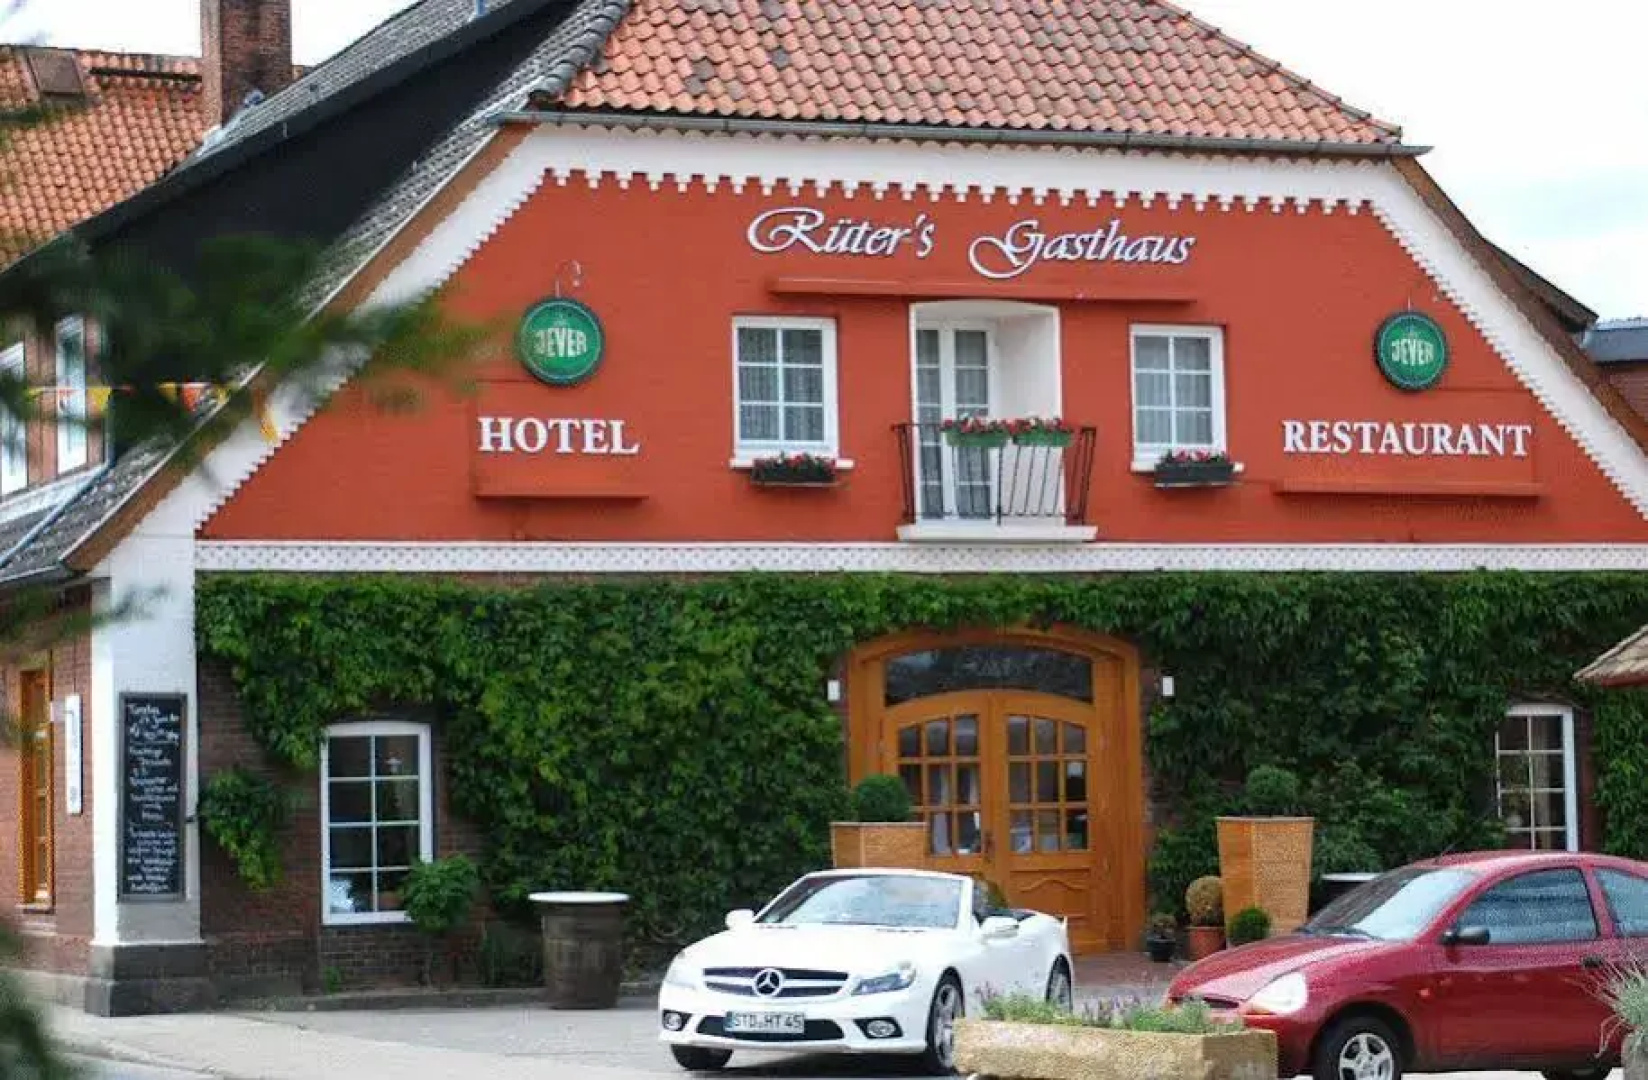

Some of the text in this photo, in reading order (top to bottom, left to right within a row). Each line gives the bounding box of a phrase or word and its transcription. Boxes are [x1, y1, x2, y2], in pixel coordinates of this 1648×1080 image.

[747, 207, 1195, 279] Rüter's Gasthaus
[534, 328, 587, 358] JEVER
[1391, 338, 1434, 366] JEVER
[478, 417, 640, 455] HOTEL
[1282, 420, 1532, 457] RESTAURANT
